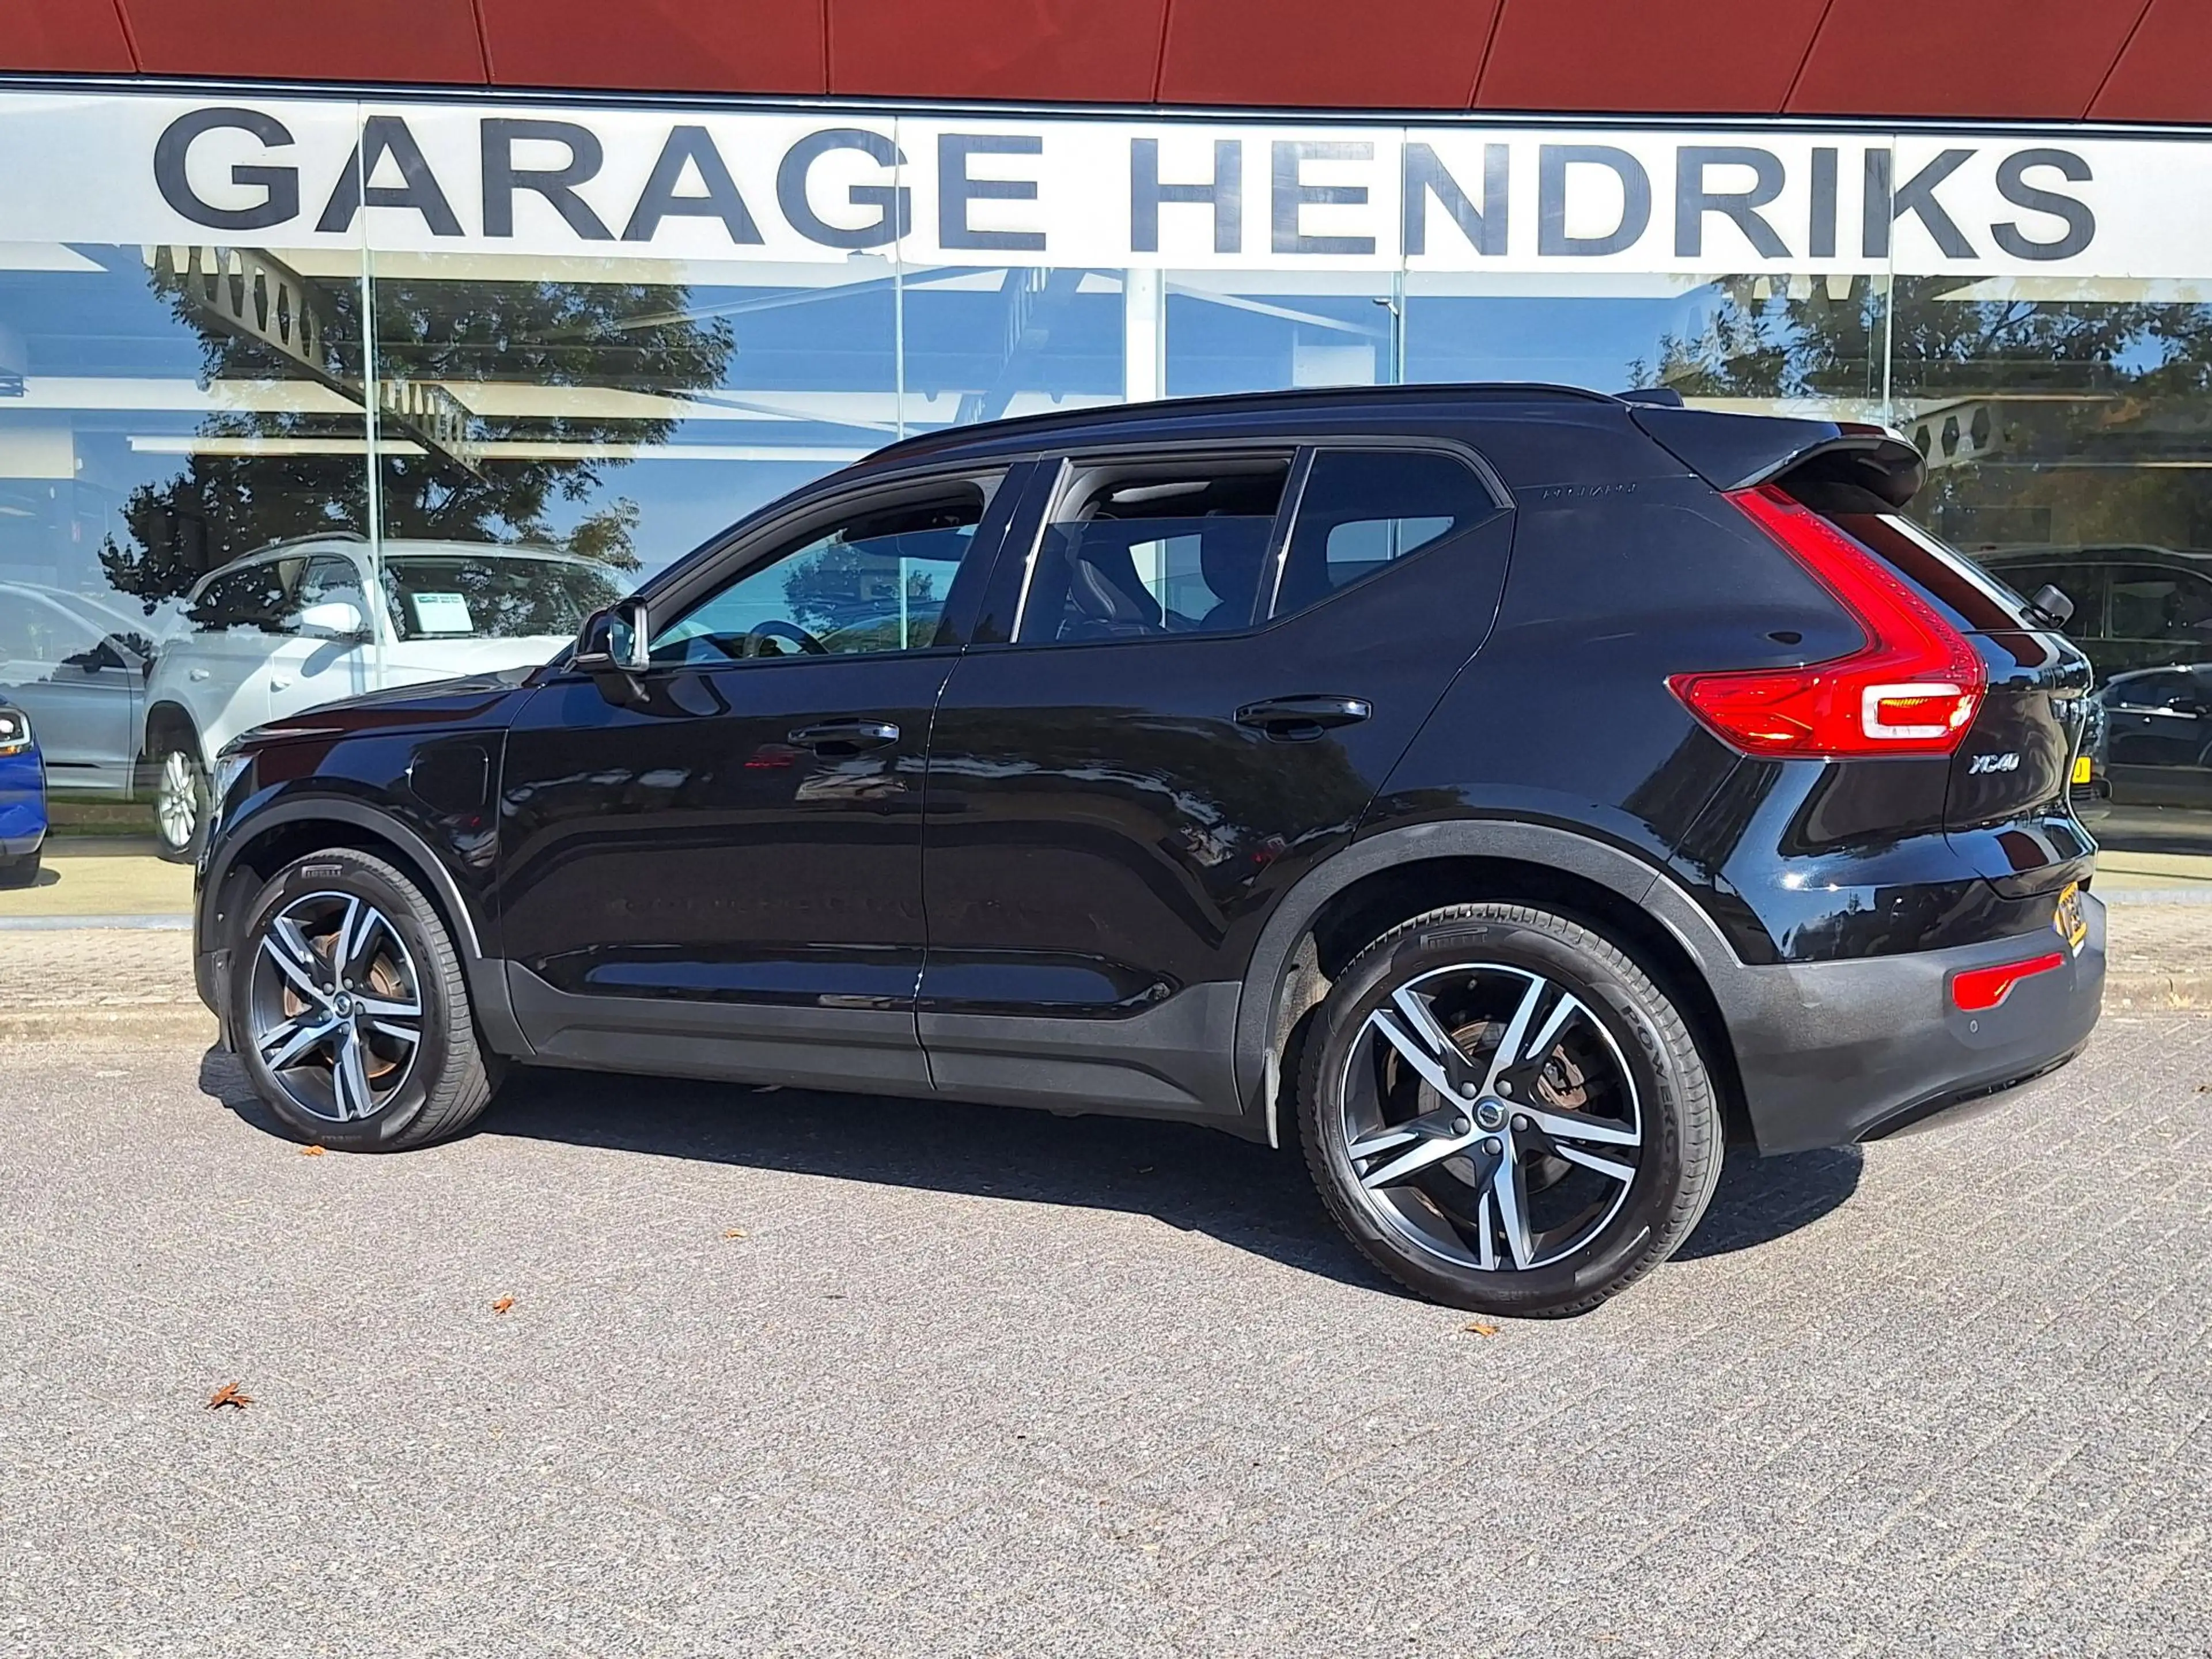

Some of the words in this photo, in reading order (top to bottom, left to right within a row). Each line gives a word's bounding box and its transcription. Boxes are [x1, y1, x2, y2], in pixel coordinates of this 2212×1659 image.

[154, 107, 1046, 251] GARAGE
[1131, 138, 2096, 260] HENDRIKS
[1968, 753, 2020, 774] XC40
